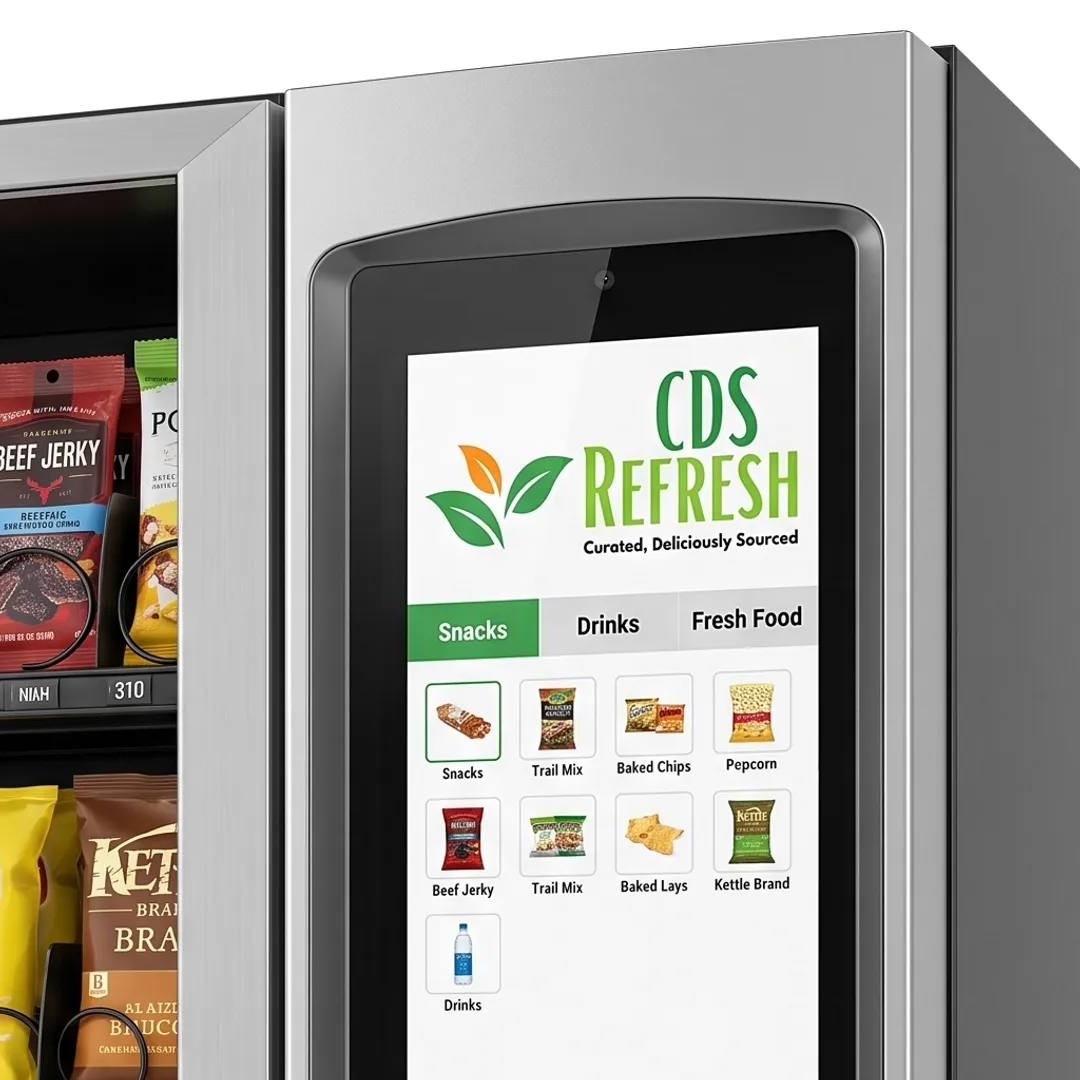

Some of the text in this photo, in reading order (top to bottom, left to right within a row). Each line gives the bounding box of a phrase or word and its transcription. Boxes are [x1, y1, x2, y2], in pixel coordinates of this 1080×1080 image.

[656, 366, 758, 451] CDS
[41, 439, 101, 469] JERKY
[583, 446, 799, 528] REFRESH
[583, 529, 799, 556] Curated, Deliciously Sourced
[577, 614, 640, 636] Drinks
[692, 605, 803, 631] Fresh Food
[438, 620, 508, 643] Snacks
[114, 681, 145, 699] 310
[442, 766, 484, 780] Snacks
[532, 764, 584, 777] Trail Mix
[617, 759, 691, 777] Baked Chips
[726, 758, 778, 773] Pepcorn
[432, 883, 494, 899] Beef Jerky
[532, 881, 584, 895] Trail Mix
[620, 879, 688, 895] Baked Lays
[714, 877, 790, 891] Kettle Brand
[444, 998, 482, 1012] Drinks
